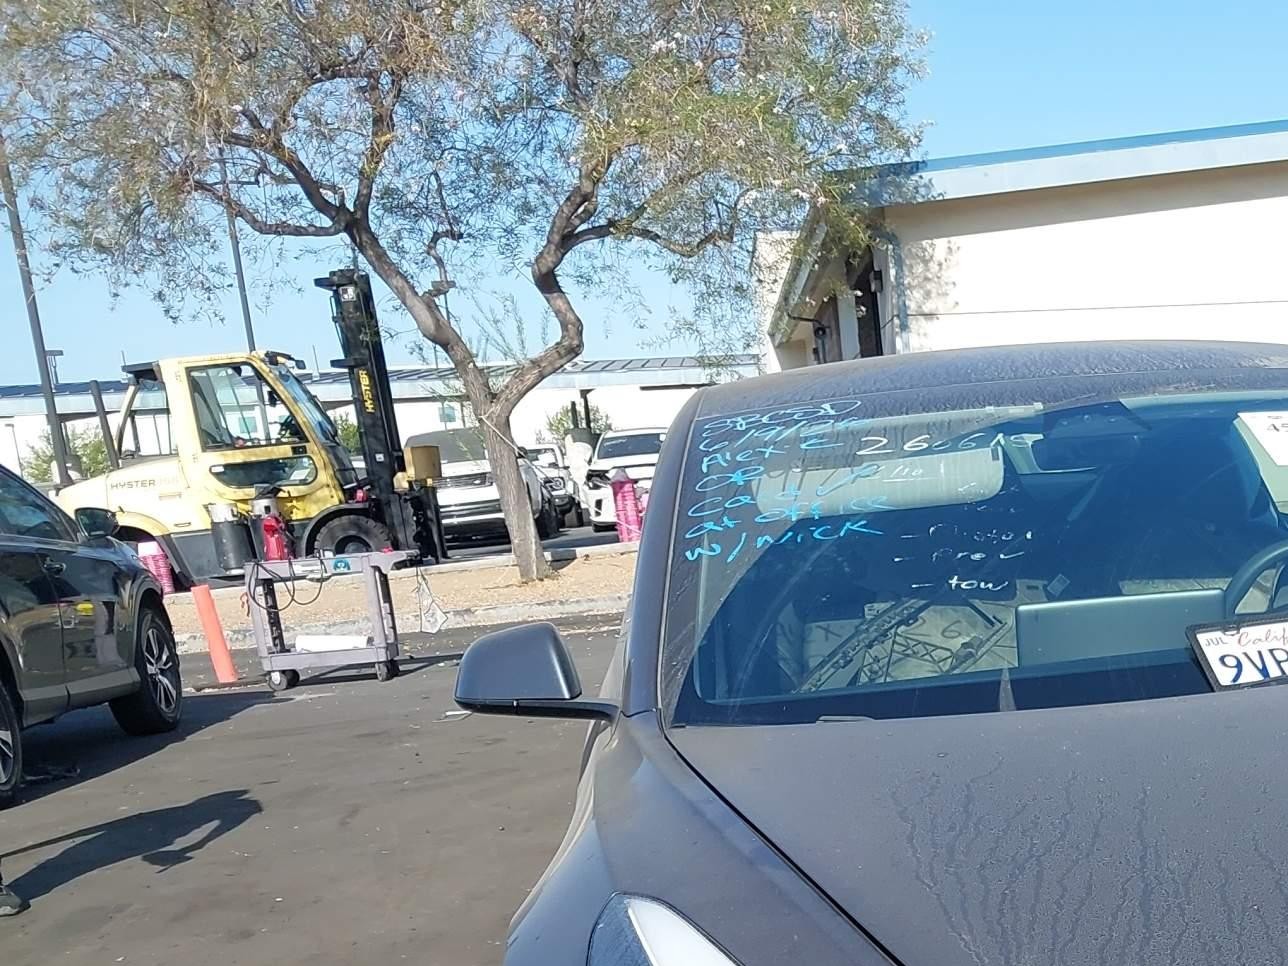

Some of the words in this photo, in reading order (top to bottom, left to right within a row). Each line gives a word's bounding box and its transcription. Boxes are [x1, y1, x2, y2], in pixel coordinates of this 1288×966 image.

[359, 369, 376, 413] HYSTER
[110, 479, 156, 490] HYSTER
[1205, 637, 1229, 648] JUL
